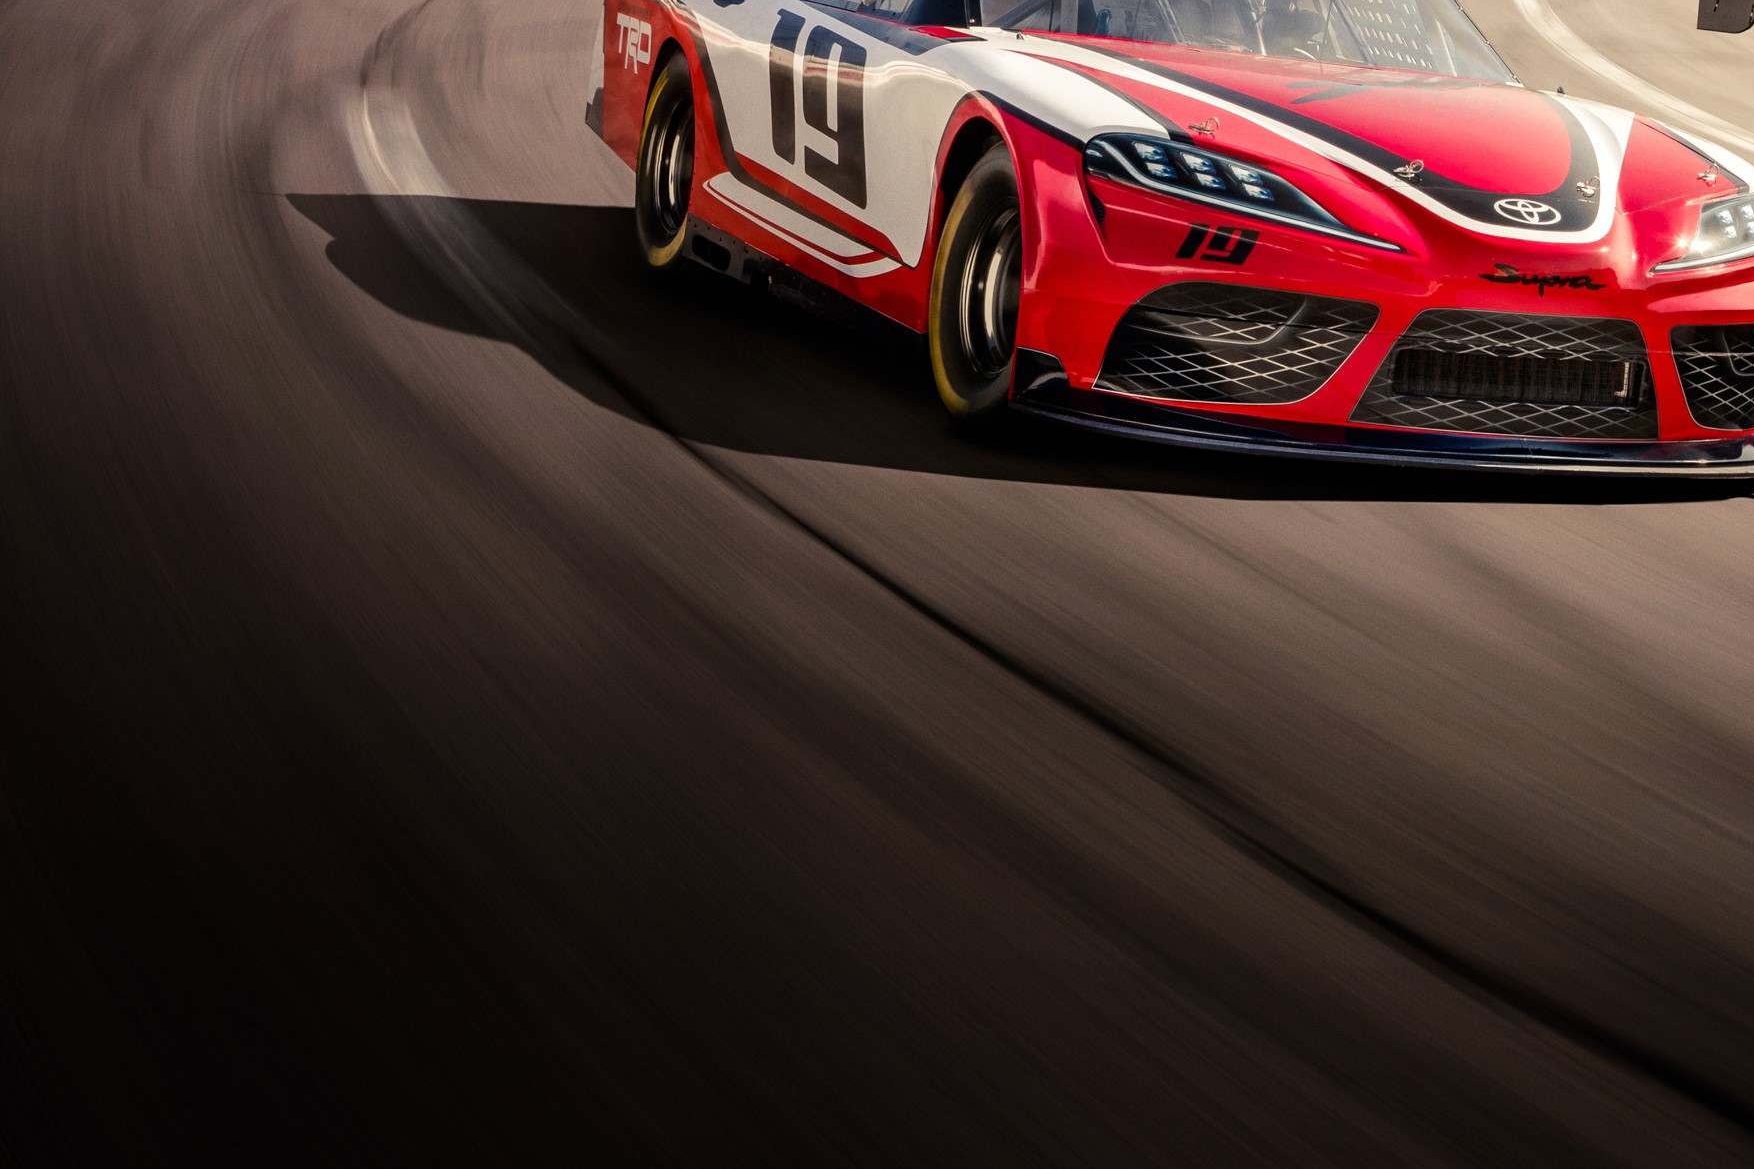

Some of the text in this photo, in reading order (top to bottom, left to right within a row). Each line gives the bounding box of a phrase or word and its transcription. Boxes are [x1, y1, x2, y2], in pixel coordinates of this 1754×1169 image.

[616, 12, 652, 75] TRD
[769, 8, 868, 210] 19
[1175, 222, 1260, 265] 19
[1479, 262, 1607, 298] Supra
